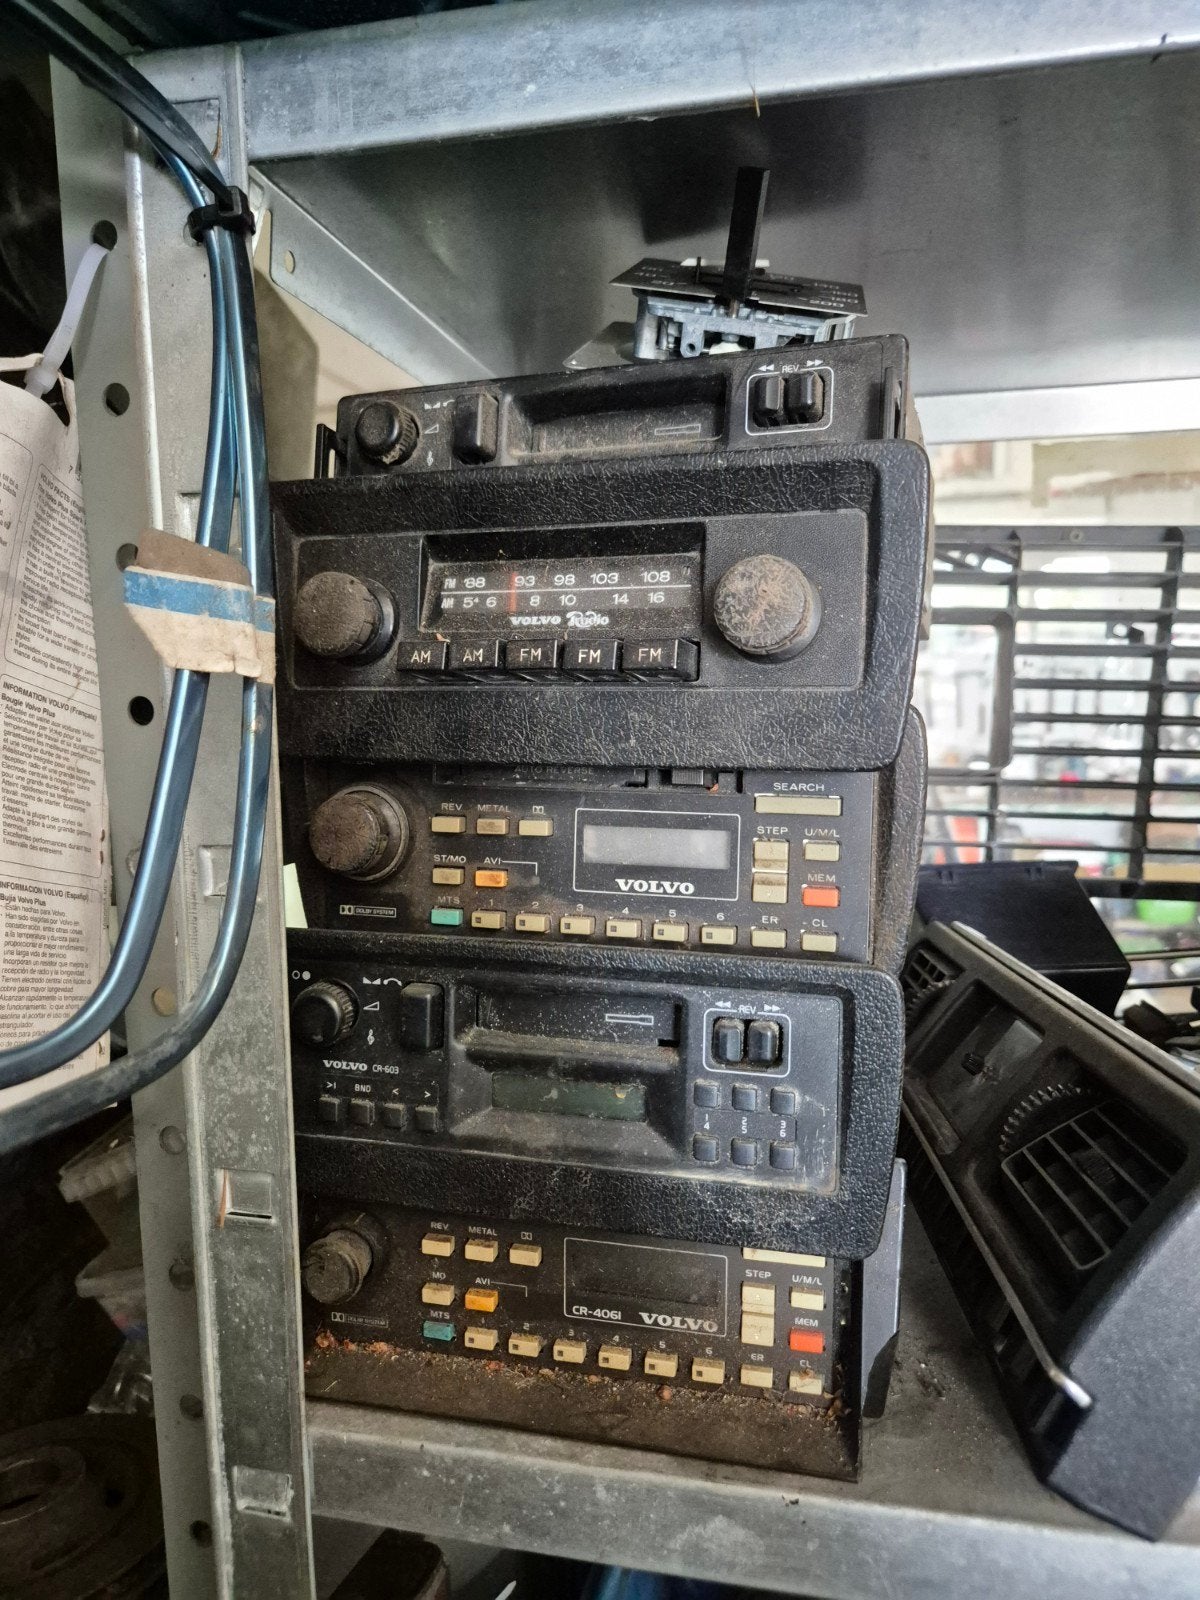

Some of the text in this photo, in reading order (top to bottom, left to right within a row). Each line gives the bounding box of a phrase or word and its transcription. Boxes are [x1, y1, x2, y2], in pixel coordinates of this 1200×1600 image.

[781, 364, 799, 373] REV
[444, 578, 456, 589] FM
[515, 575, 536, 587] 93
[554, 574, 576, 586] 98
[590, 573, 619, 584] 103
[641, 570, 671, 583] 108
[486, 597, 498, 608] 6
[529, 595, 540, 606] 8
[559, 594, 577, 606] 10
[613, 593, 630, 605] 14
[648, 592, 665, 603] 16
[510, 611, 610, 628] VOLVO Radio
[411, 650, 432, 664] AM
[463, 648, 484, 662] AM
[520, 648, 542, 662] FM
[578, 650, 601, 663] FM
[638, 648, 662, 662] FM
[3, 681, 47, 703] INFORMATION
[48, 698, 70, 711] VOLVO
[1, 693, 23, 706] Bougie
[42, 708, 56, 718] Plus
[773, 782, 825, 792] SEARCH
[441, 802, 463, 811] REV
[477, 804, 511, 813] METAL
[757, 826, 789, 835] STEP
[805, 828, 840, 838] U/M/L
[433, 854, 467, 863] ST/MO
[484, 857, 501, 865] AVI
[807, 873, 836, 883] MEM
[0, 881, 42, 894] INFORMACION
[43, 888, 63, 898] VOLVO
[615, 878, 695, 895] VOLVO
[34, 898, 46, 906] Plus
[438, 896, 460, 904] MTS
[489, 898, 494, 906] 1
[531, 901, 540, 909] 2
[576, 903, 584, 911] 3
[621, 906, 630, 915] 4
[668, 909, 677, 918] 5
[716, 912, 725, 921] 6
[761, 915, 779, 924] ER
[812, 919, 828, 928] CL
[739, 1004, 757, 1014] REV
[323, 1059, 400, 1075] VOLVO CR-603
[354, 1083, 371, 1093] BND
[741, 1116, 748, 1125] 2
[780, 1120, 787, 1129] 3
[703, 1121, 710, 1130] 4
[741, 1125, 748, 1134] 5
[779, 1129, 786, 1138] 6
[430, 1221, 449, 1231] REV
[468, 1226, 498, 1236] METAL
[432, 1272, 446, 1280] MO
[745, 1269, 772, 1279] STEP
[475, 1277, 491, 1285] AVI
[792, 1274, 823, 1285] U/M/L
[430, 1310, 450, 1319] MTS
[639, 1312, 719, 1332] VOLVO
[795, 1317, 819, 1327] MEM
[568, 1329, 575, 1337] 3
[612, 1335, 620, 1343] 4
[659, 1341, 666, 1349] 5
[705, 1347, 713, 1355] 6
[751, 1353, 764, 1362] ER
[800, 1360, 812, 1368] CL
